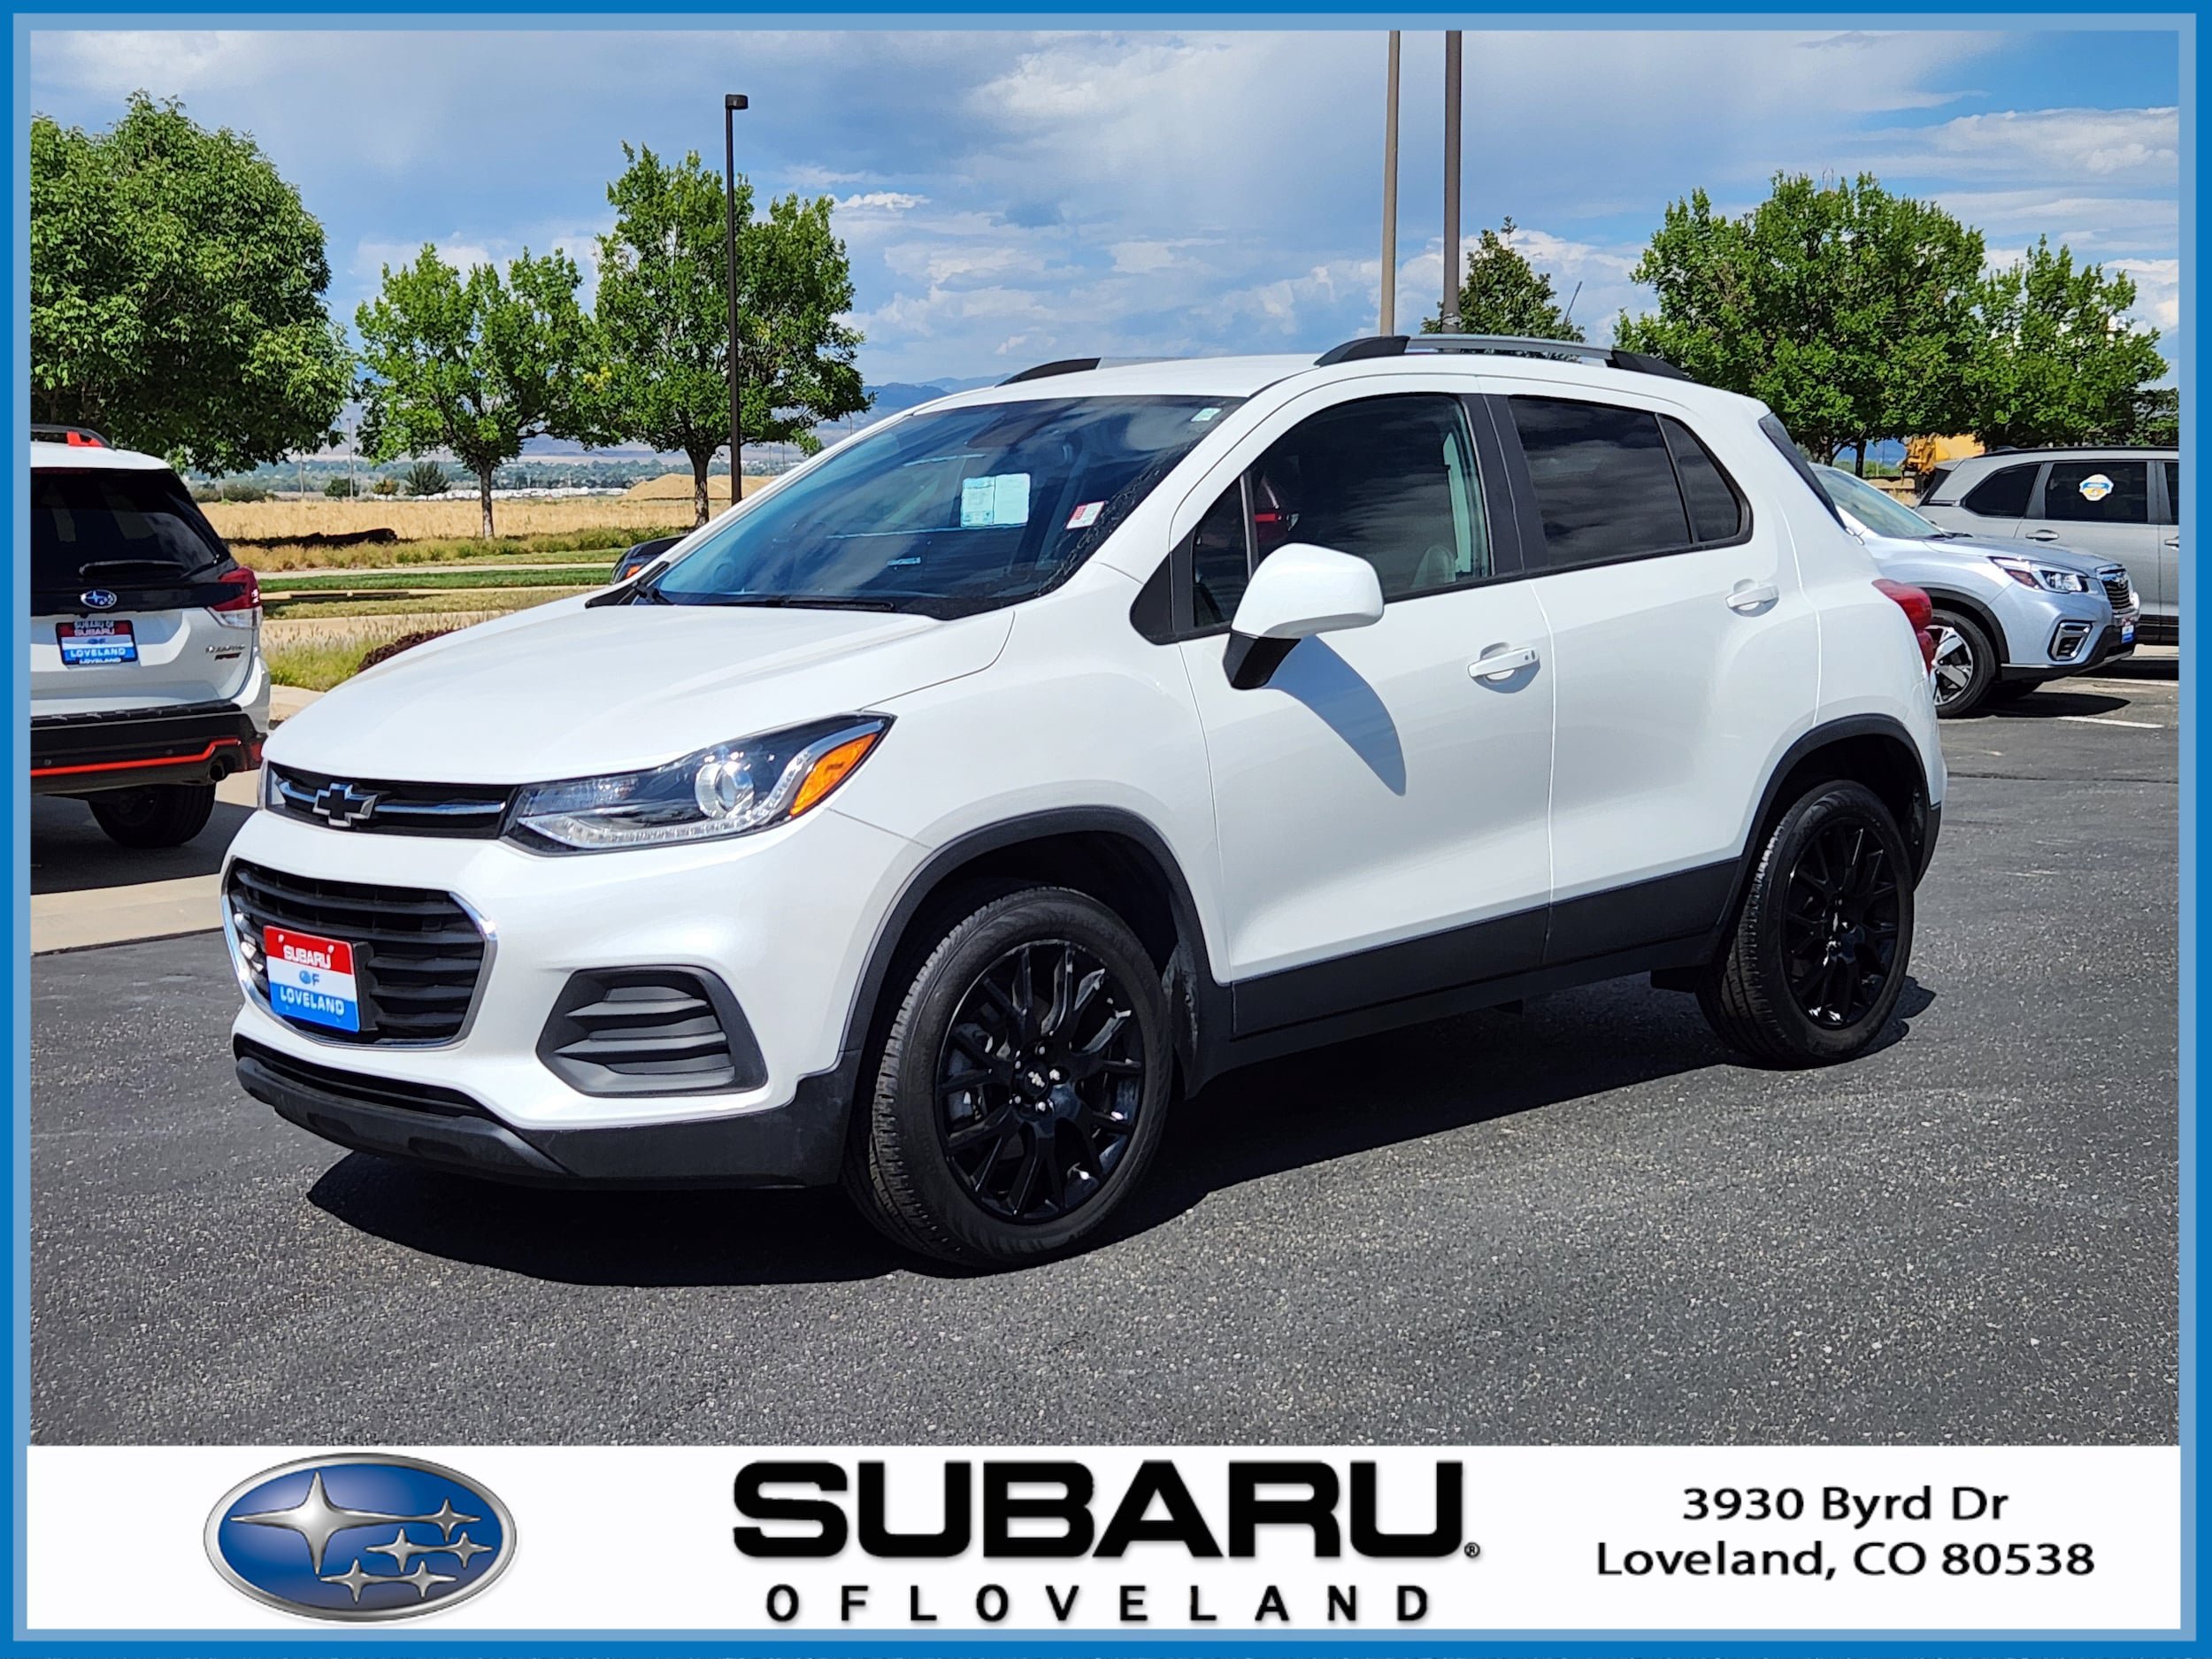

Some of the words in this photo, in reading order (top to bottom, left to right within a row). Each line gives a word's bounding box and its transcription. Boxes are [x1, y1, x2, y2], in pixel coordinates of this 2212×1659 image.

[70, 648, 127, 658] LOVELAND
[283, 944, 331, 970] SUBARU
[280, 986, 344, 1016] LOVELAND
